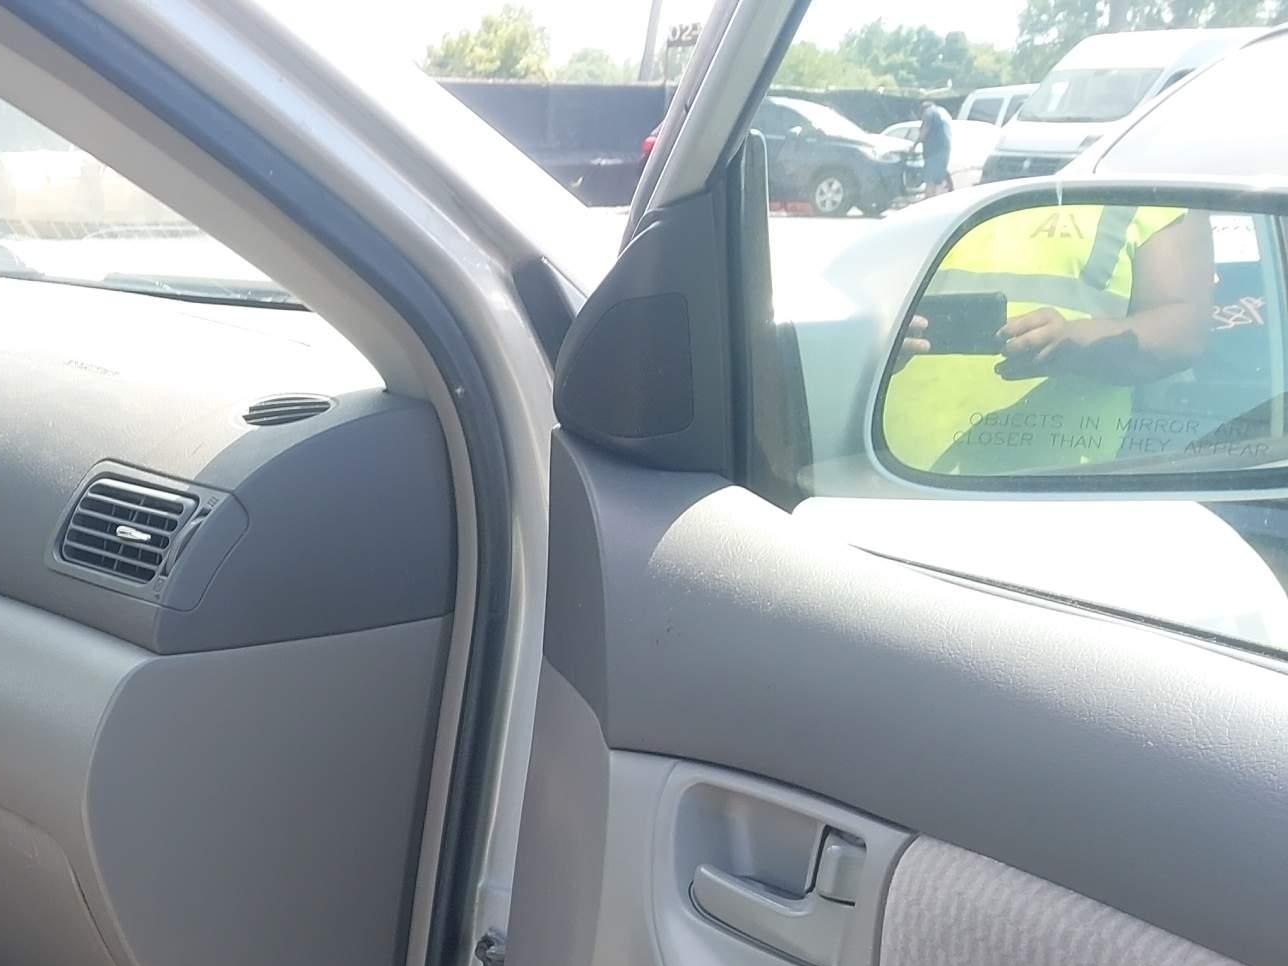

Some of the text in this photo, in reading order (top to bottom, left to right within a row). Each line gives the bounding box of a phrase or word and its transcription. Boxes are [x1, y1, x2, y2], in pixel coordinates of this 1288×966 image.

[969, 411, 1063, 429] OBJECTS
[1079, 416, 1101, 430] IN
[1116, 417, 1200, 434] MIRROR
[953, 430, 1269, 457] CLOSER THAN THEY APPEAR
